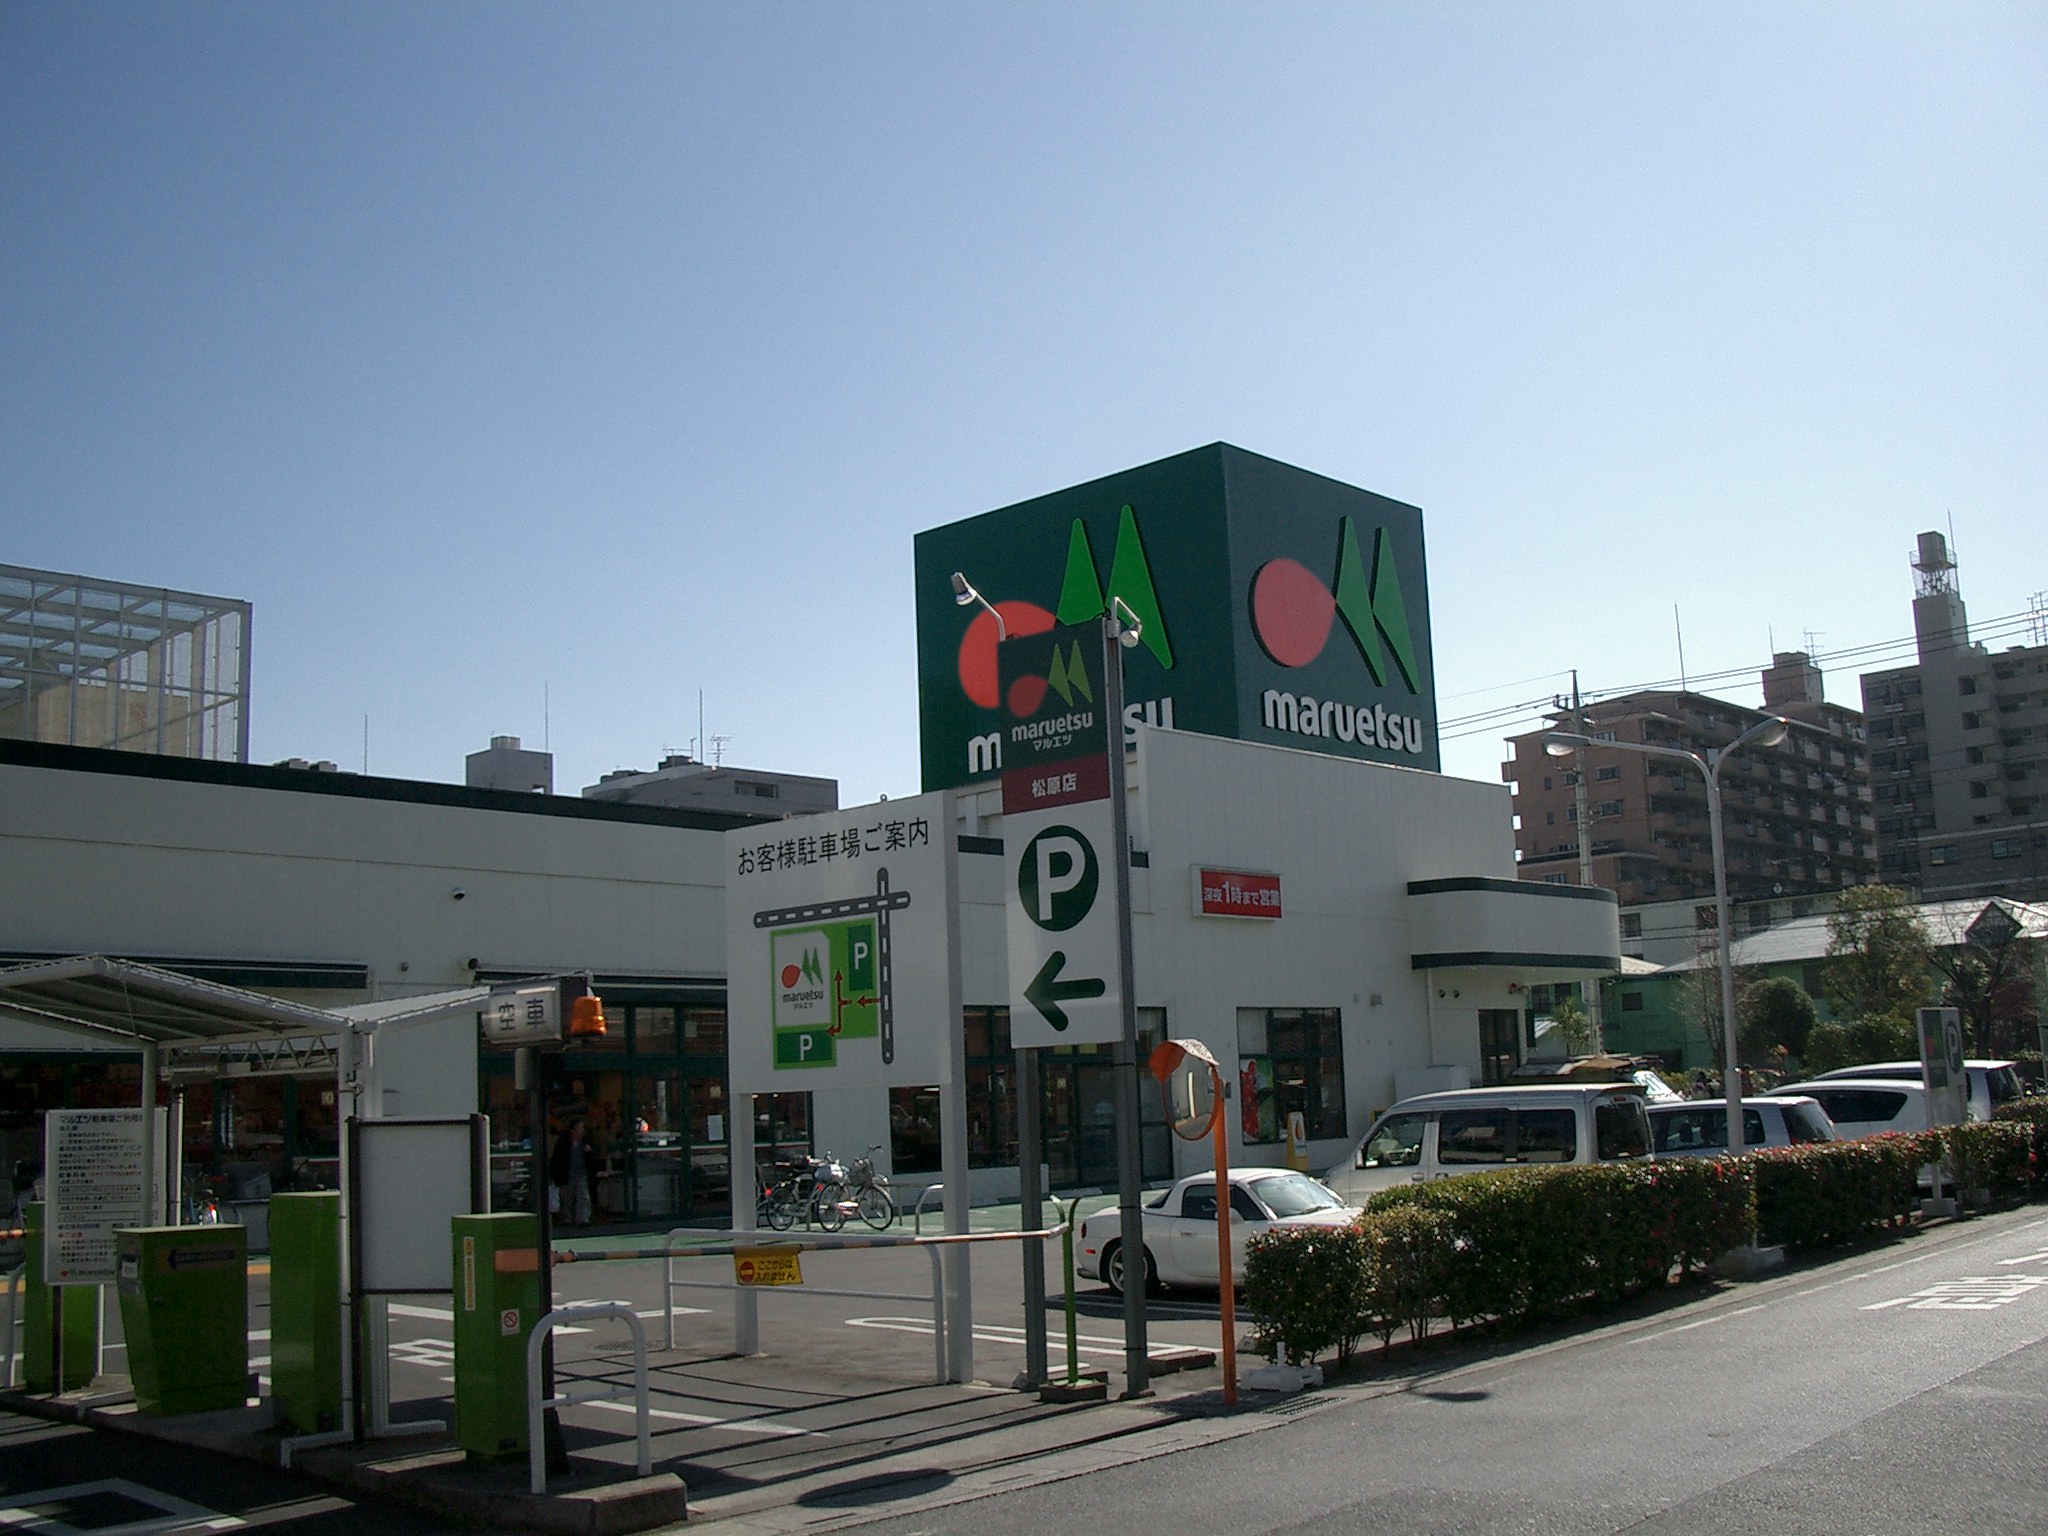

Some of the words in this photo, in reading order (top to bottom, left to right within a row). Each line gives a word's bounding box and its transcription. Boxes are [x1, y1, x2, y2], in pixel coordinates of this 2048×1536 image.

[1011, 712, 1093, 742] maruetsu
[1263, 689, 1424, 754] maruetsu
[1032, 734, 1073, 751] マルエツ
[1031, 772, 1078, 798] 松原店
[738, 818, 929, 875] お客様駐車場ご案内
[1036, 835, 1086, 921] P
[1204, 880, 1281, 907] 深夜1時まで営業
[854, 941, 868, 970] P
[782, 990, 825, 1004] maruetsu
[499, 997, 546, 1032] 空車
[799, 1034, 814, 1061] P
